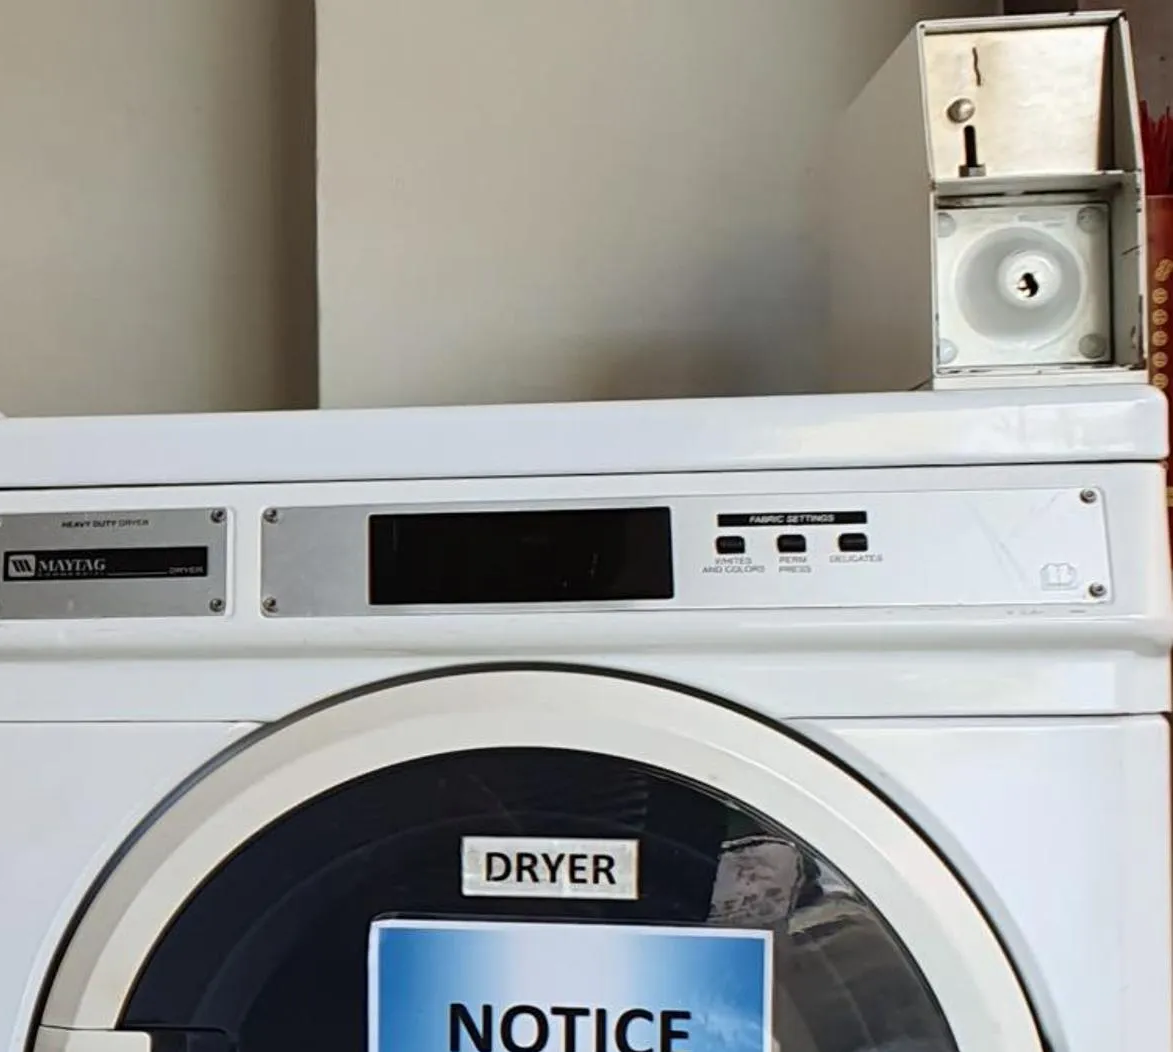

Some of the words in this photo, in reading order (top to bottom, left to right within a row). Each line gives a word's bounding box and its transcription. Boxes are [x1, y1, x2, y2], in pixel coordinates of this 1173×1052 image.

[749, 515, 785, 524] FABRIC
[786, 514, 836, 523] SETTINGS
[61, 520, 91, 529] HEAVY
[92, 519, 117, 528] DUTY
[714, 556, 753, 565] WHITES
[779, 556, 808, 564] PERM
[829, 554, 884, 563] DELICATES
[37, 558, 107, 572] MAYTAG
[702, 565, 723, 574] AND
[724, 565, 766, 573] COLORS
[778, 565, 812, 573] PRESS
[485, 851, 617, 885] DRYER
